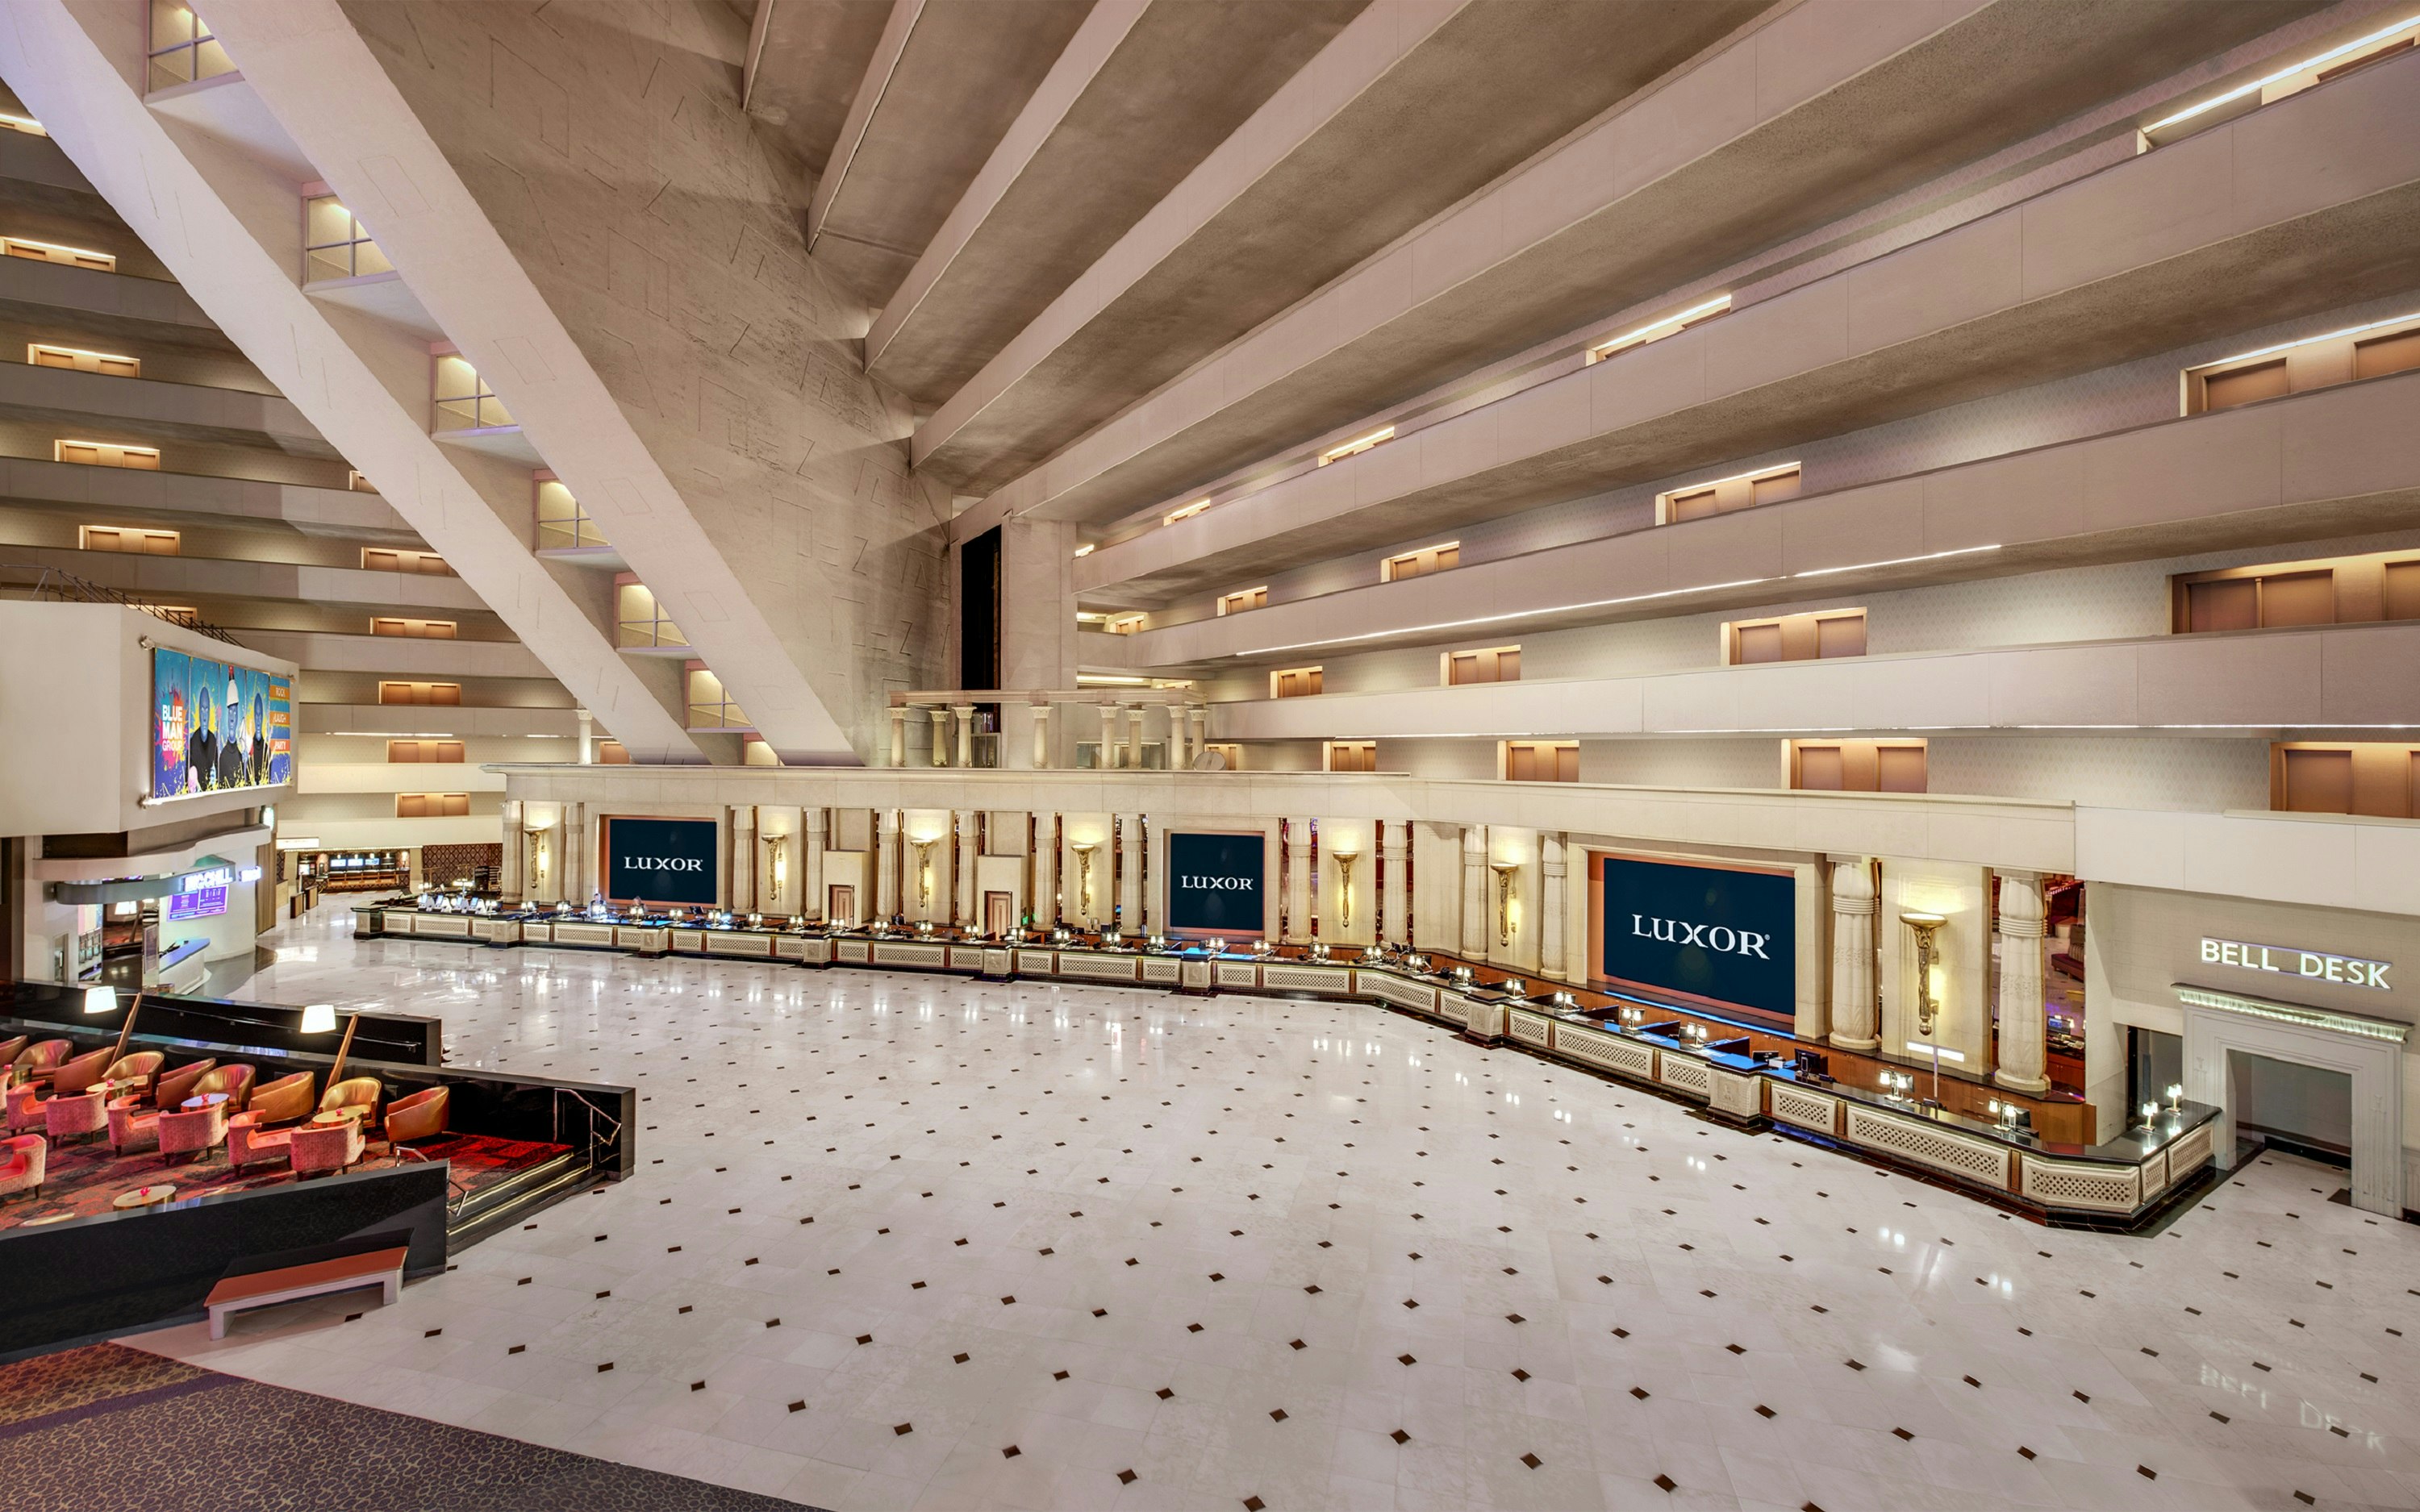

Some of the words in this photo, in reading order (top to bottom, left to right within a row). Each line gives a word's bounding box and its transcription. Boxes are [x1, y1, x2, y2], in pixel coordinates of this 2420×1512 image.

[162, 704, 183, 722] BLUE
[162, 722, 183, 739] MAN
[162, 739, 184, 752] GROUP
[624, 856, 703, 872] LUXOR
[1181, 876, 1253, 890] LUXOR
[2201, 939, 2280, 972] BELL
[2300, 952, 2392, 989] DESK
